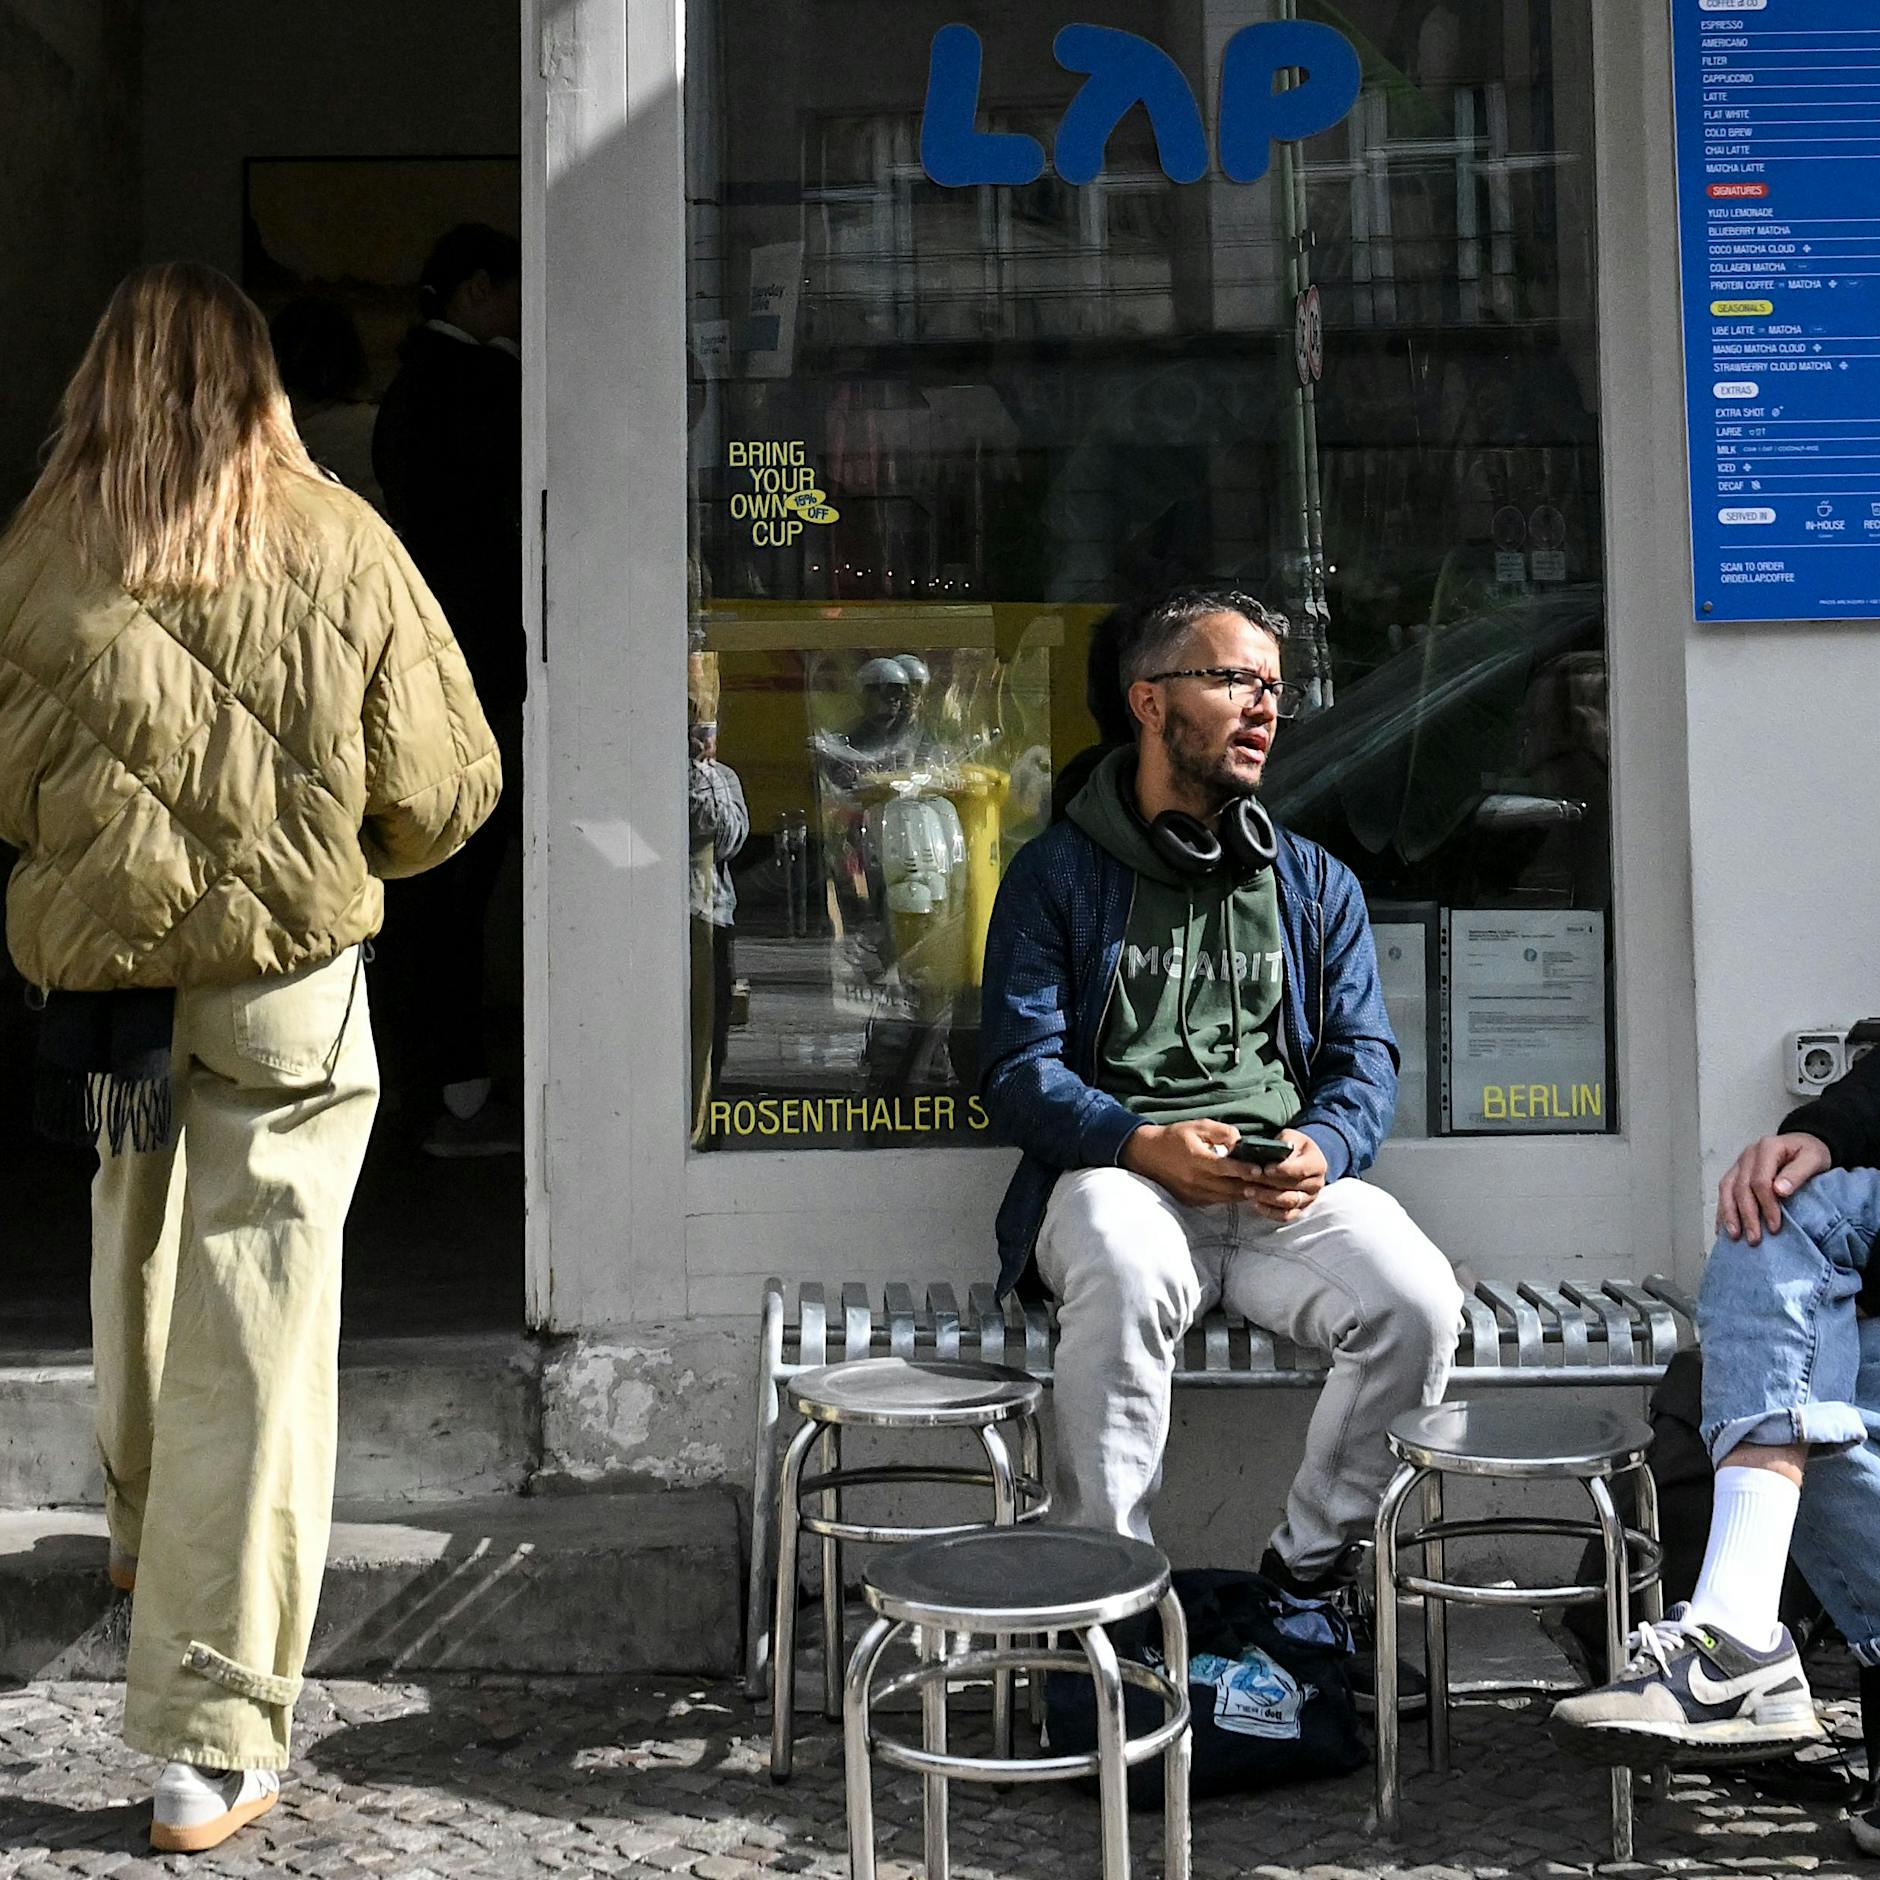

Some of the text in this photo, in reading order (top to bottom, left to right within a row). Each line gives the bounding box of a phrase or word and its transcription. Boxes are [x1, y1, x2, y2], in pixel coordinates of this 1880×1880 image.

[1701, 21, 1743, 30] ESPRESSO
[1702, 38, 1748, 47] AMERICANO
[1702, 57, 1727, 65] FILTER
[1703, 74, 1754, 83] CAPPUCCINO
[1704, 92, 1727, 101] LATTE
[923, 21, 1361, 187] LAP
[1704, 110, 1749, 119] FLAT WHITE
[1705, 128, 1752, 137] COLD BREW
[1706, 146, 1750, 155] CHAI LATTE
[1706, 164, 1765, 173] MATCHA LATTE
[1713, 186, 1762, 195] SIGNATURES
[1708, 209, 1773, 217] YUZU LEMONADE
[1709, 226, 1790, 235] BLUEBERRY MATCHA
[1709, 244, 1795, 254] COCO MATCHA CLOUD
[1710, 263, 1786, 272] COLLAGEN MATCHA
[1711, 281, 1743, 290] PROTEIN
[1746, 281, 1774, 289] COFFEE
[1788, 280, 1821, 288] MATCHA
[1718, 303, 1765, 313] SEASONALS
[1712, 327, 1728, 335] UBE
[1731, 326, 1754, 334] LATTE
[1769, 325, 1801, 334] MATCHA
[1713, 344, 1805, 353] MANGO MATCHA CLOUD
[1714, 362, 1832, 372] STRAWBERRY CLOUD MATCHA
[1721, 386, 1752, 395] EXTRAS
[1716, 408, 1764, 417] EXTRA SHOT
[1716, 427, 1742, 436] LARGE
[728, 440, 805, 467] BRING
[1717, 445, 1736, 454] MILK
[1718, 464, 1736, 472] ICED
[749, 467, 815, 492] YOUR
[1719, 481, 1743, 490] DECAF
[795, 493, 817, 506] 15%
[730, 493, 787, 519] OWN
[808, 507, 828, 520] OFF
[1726, 512, 1767, 521] SERVED IN
[1806, 521, 1845, 530] IN-HOUSE
[752, 522, 804, 547] CUP
[1721, 562, 1784, 572] SCAN TO ORDER
[1483, 1083, 1601, 1118] BERLIN
[710, 1096, 955, 1136] ROSENTHALER
